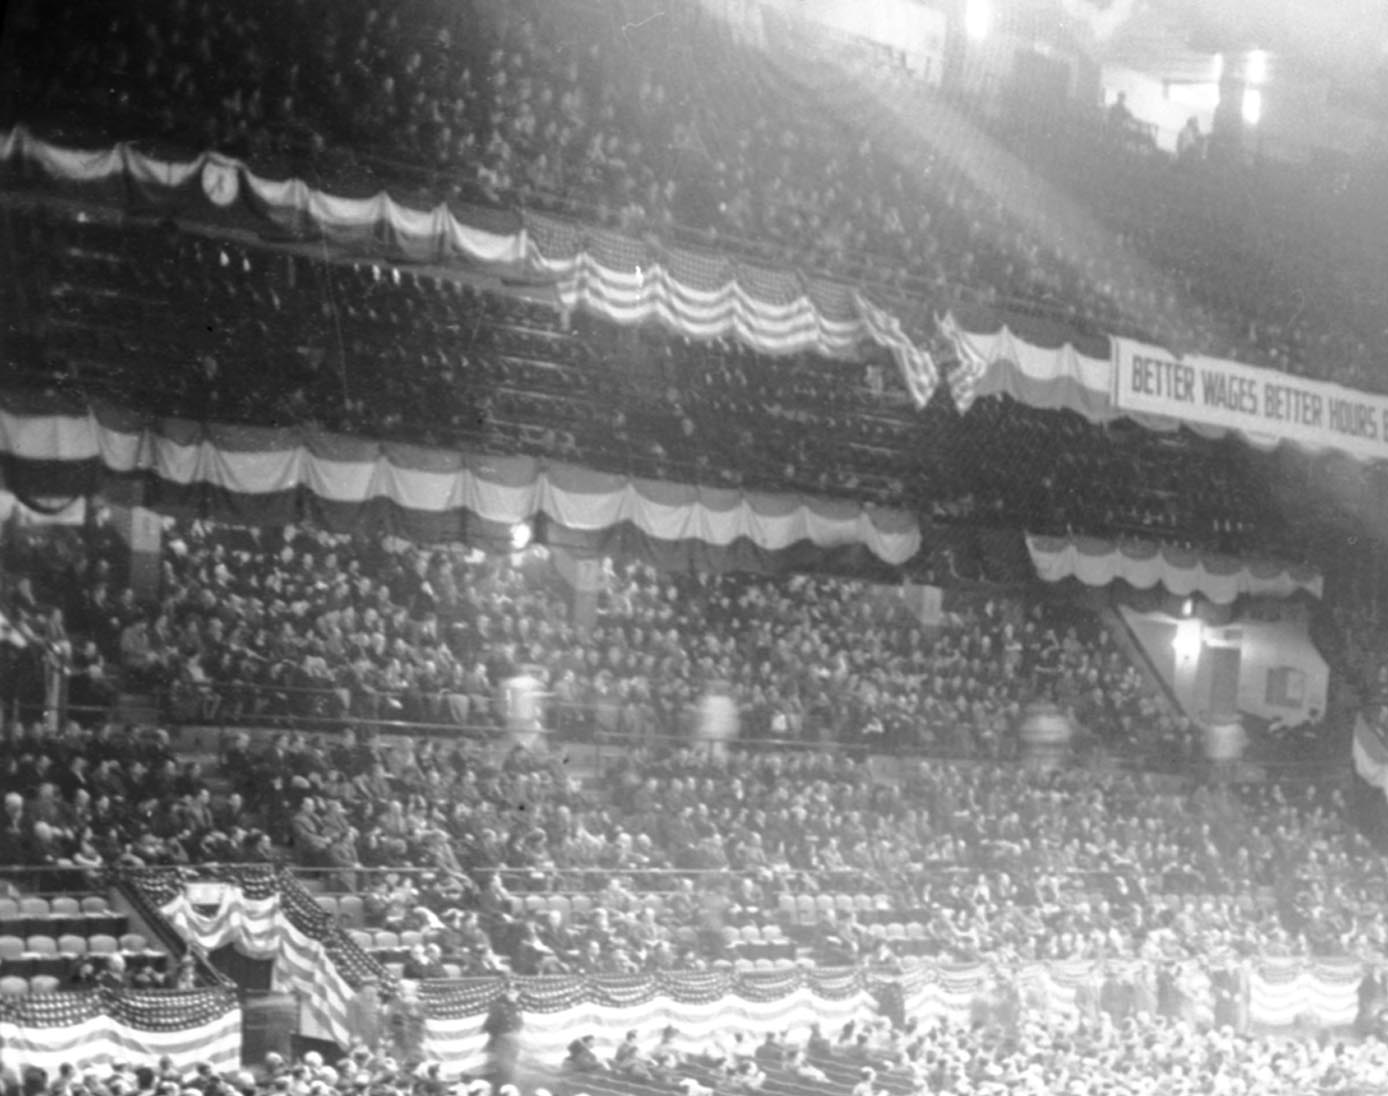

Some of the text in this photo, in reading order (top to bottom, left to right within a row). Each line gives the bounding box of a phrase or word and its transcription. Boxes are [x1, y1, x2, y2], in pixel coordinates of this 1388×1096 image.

[1132, 355, 1195, 404] BETTER
[1201, 369, 1258, 416] WAGES
[1264, 382, 1322, 427] BETTER
[1329, 396, 1378, 440] HOURS
